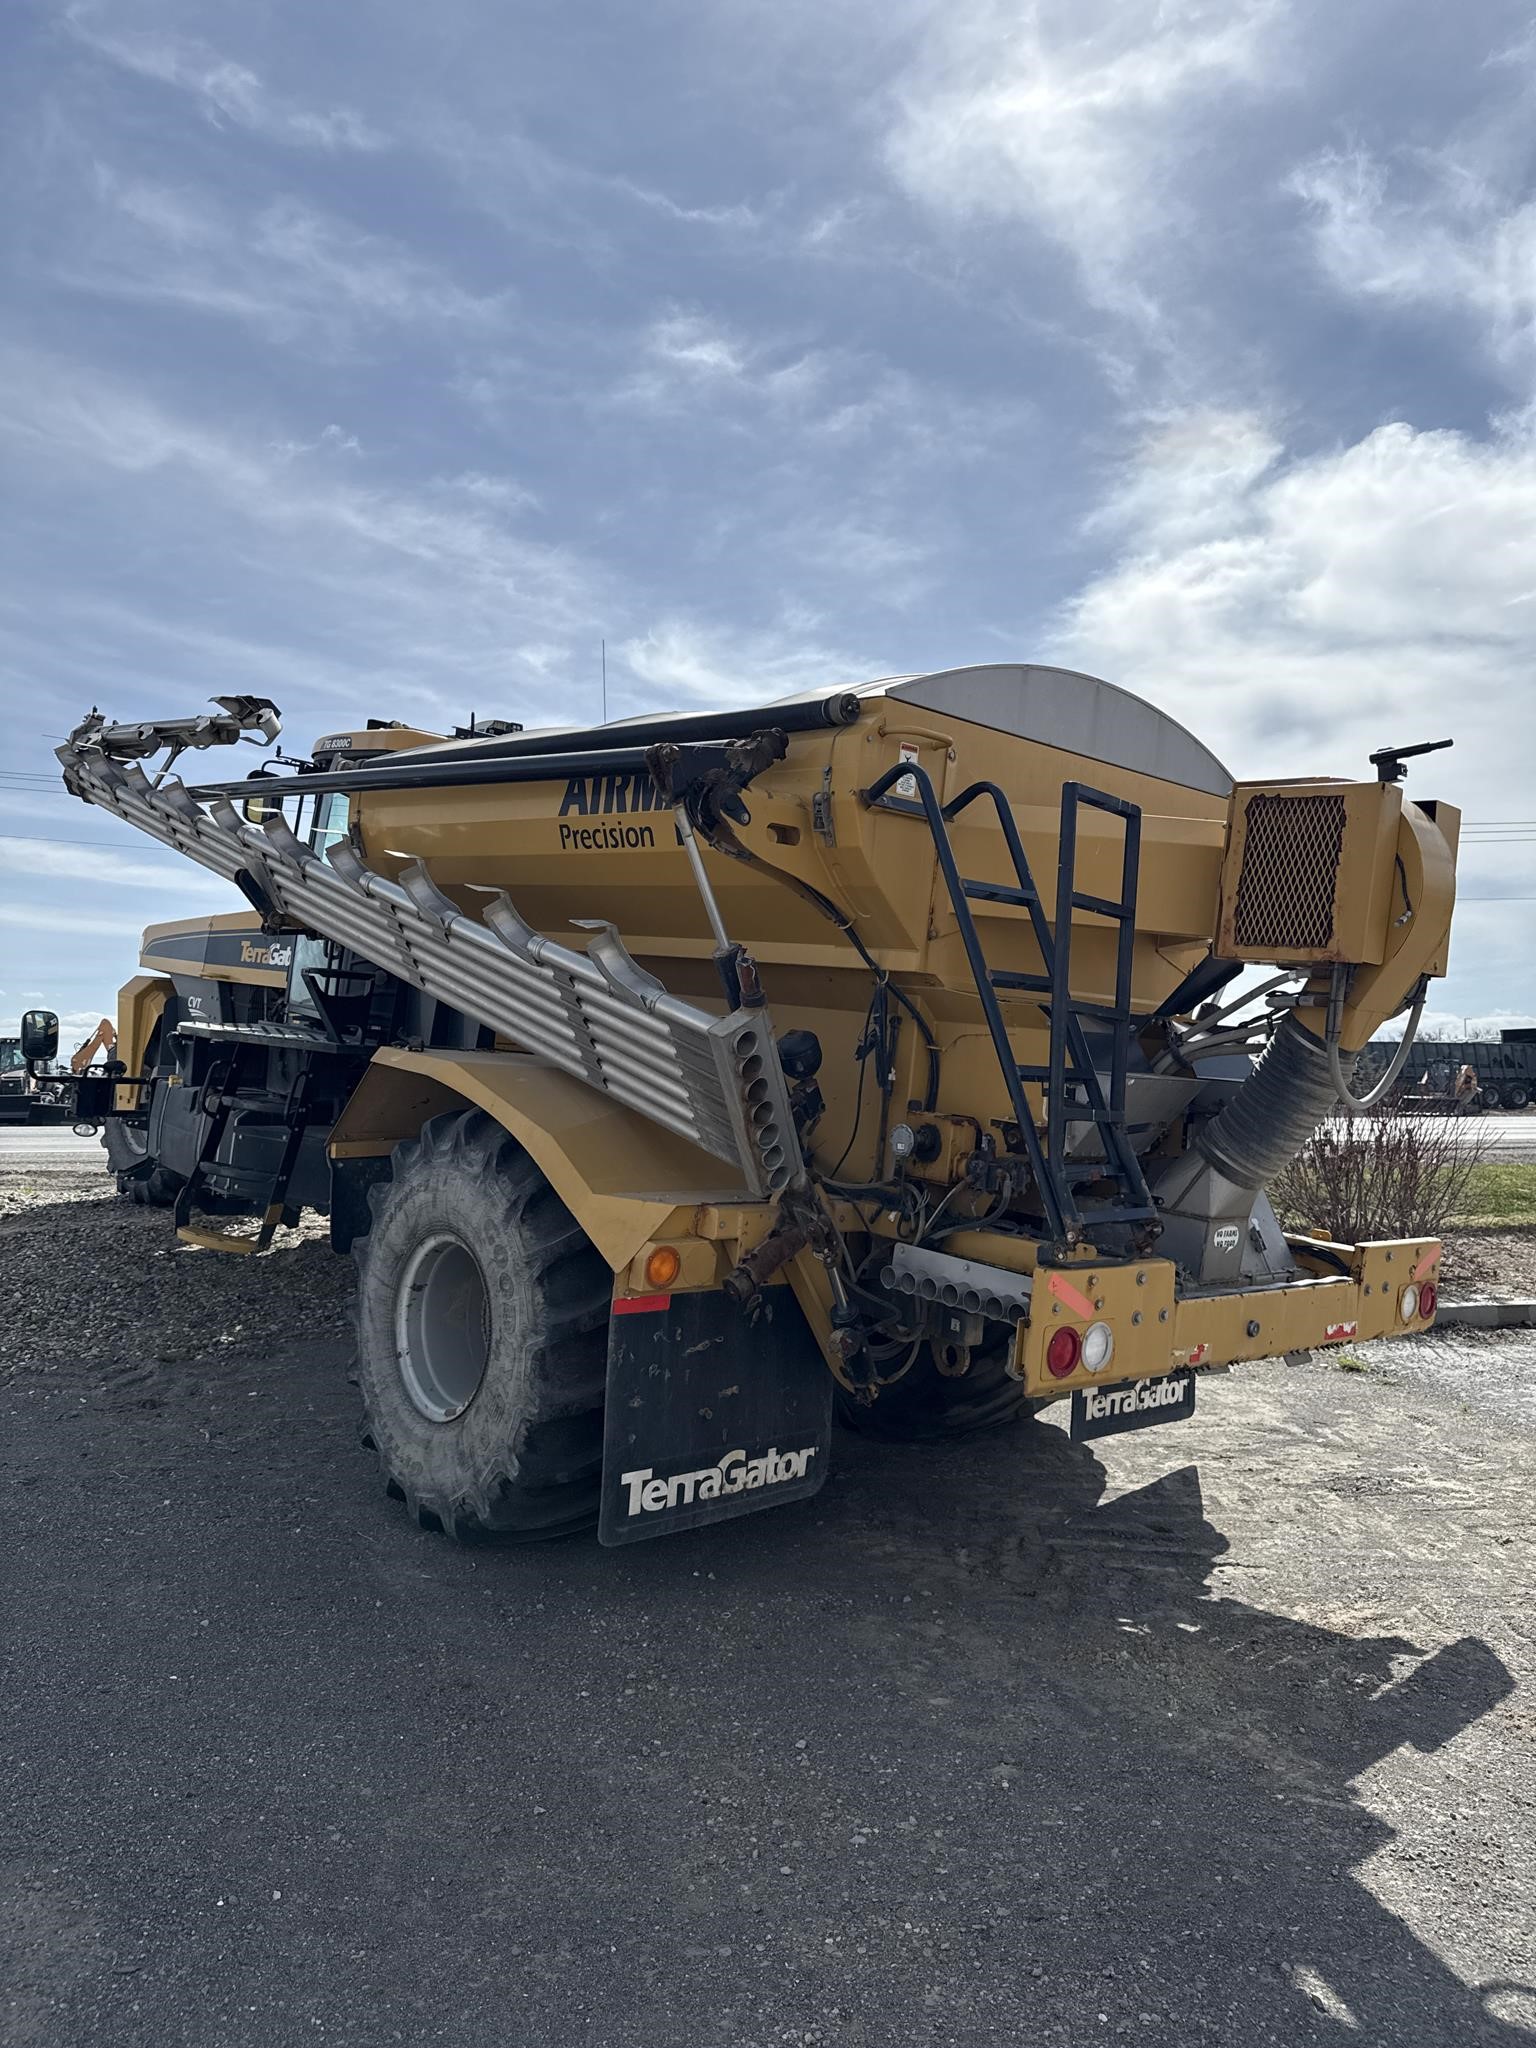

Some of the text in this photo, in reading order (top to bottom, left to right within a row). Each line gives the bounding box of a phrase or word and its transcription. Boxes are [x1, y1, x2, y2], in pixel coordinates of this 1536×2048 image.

[558, 821, 655, 850] Precision
[187, 996, 202, 1009] CVT
[1082, 1377, 1189, 1421] TerraGator
[621, 1448, 815, 1517] TerraGator
